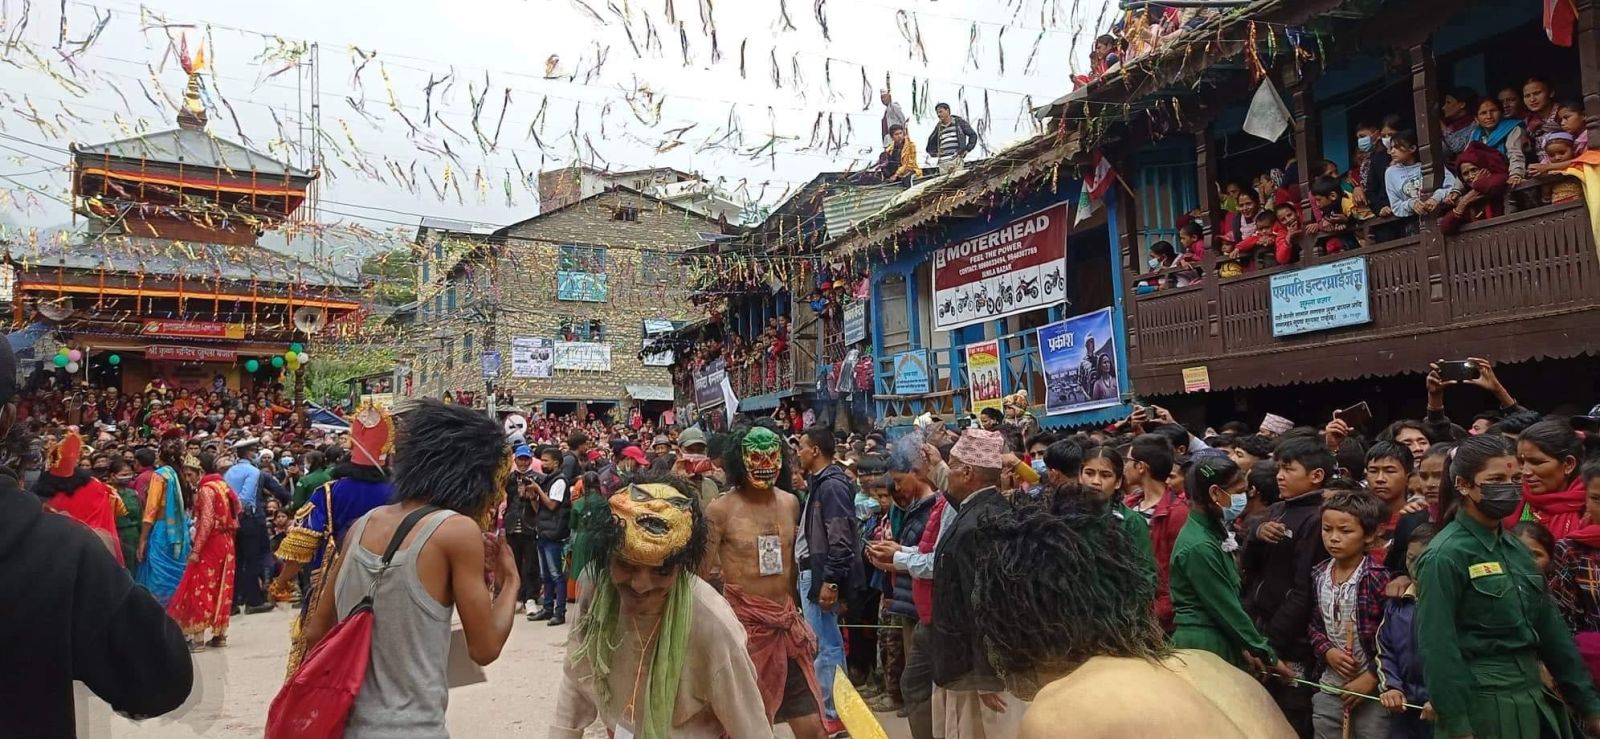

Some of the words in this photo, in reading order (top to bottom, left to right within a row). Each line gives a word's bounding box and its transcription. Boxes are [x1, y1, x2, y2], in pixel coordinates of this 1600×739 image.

[947, 215, 1050, 261] MOTERHEAD
[969, 254, 984, 264] FEEL
[985, 249, 997, 259] THE
[998, 241, 1023, 256] POWER
[996, 263, 1013, 274] BAZAR
[1272, 277, 1304, 303] पशुपति
[1047, 331, 1075, 353] प्रकाश
